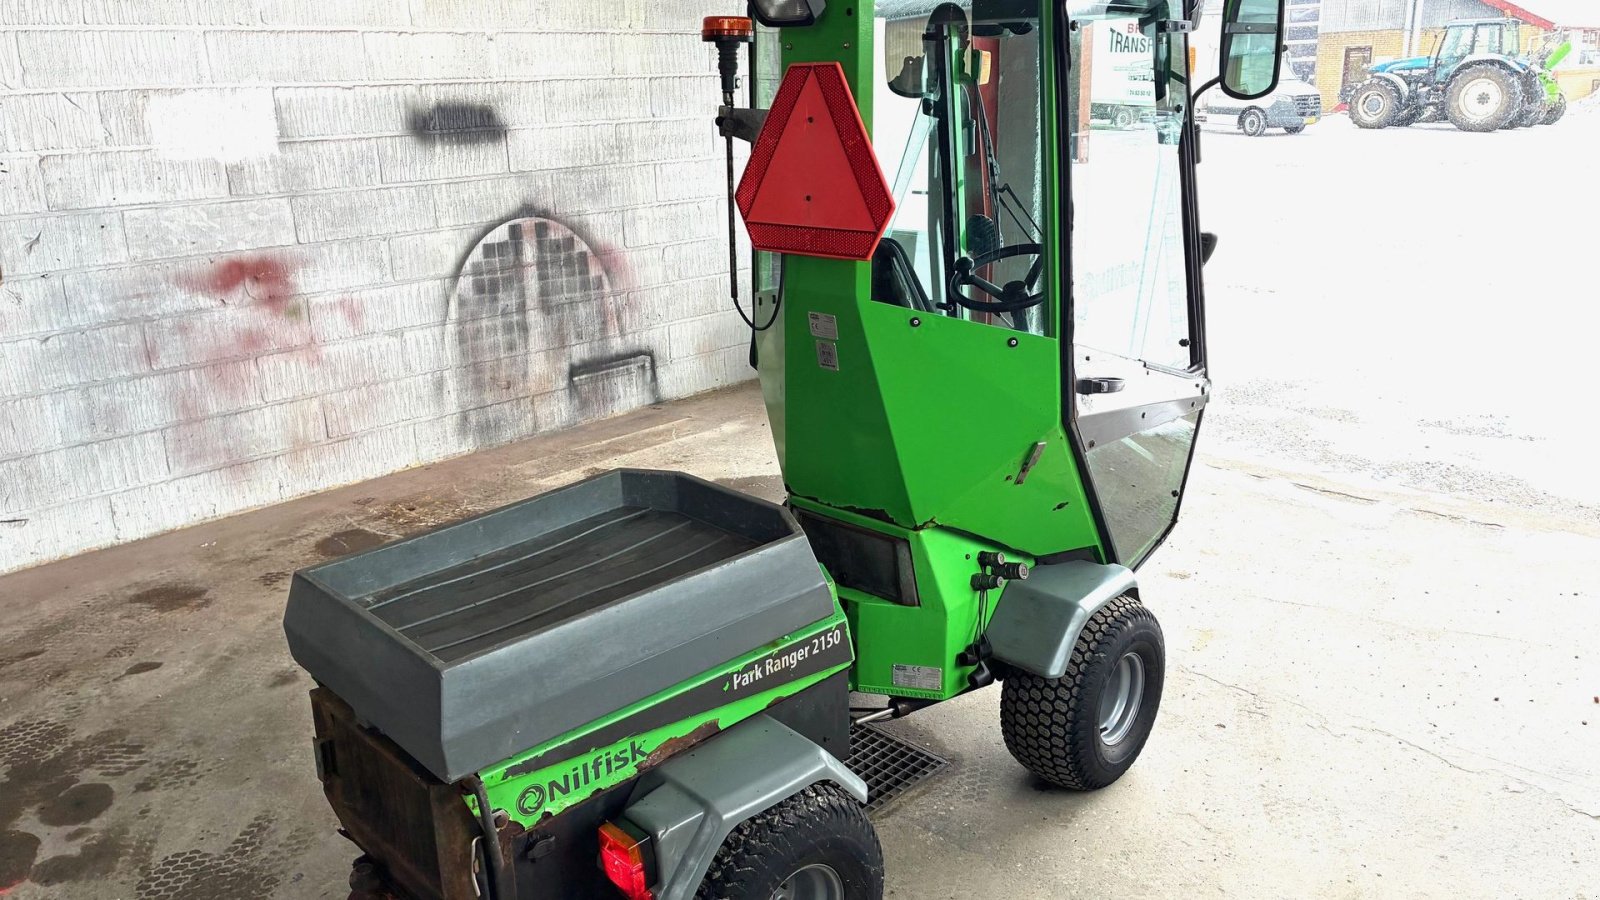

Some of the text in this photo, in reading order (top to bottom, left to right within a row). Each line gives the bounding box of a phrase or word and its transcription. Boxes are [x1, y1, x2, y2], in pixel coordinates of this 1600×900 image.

[733, 629, 841, 690] Park Ranger 2150
[548, 740, 648, 803] Nilfisk
